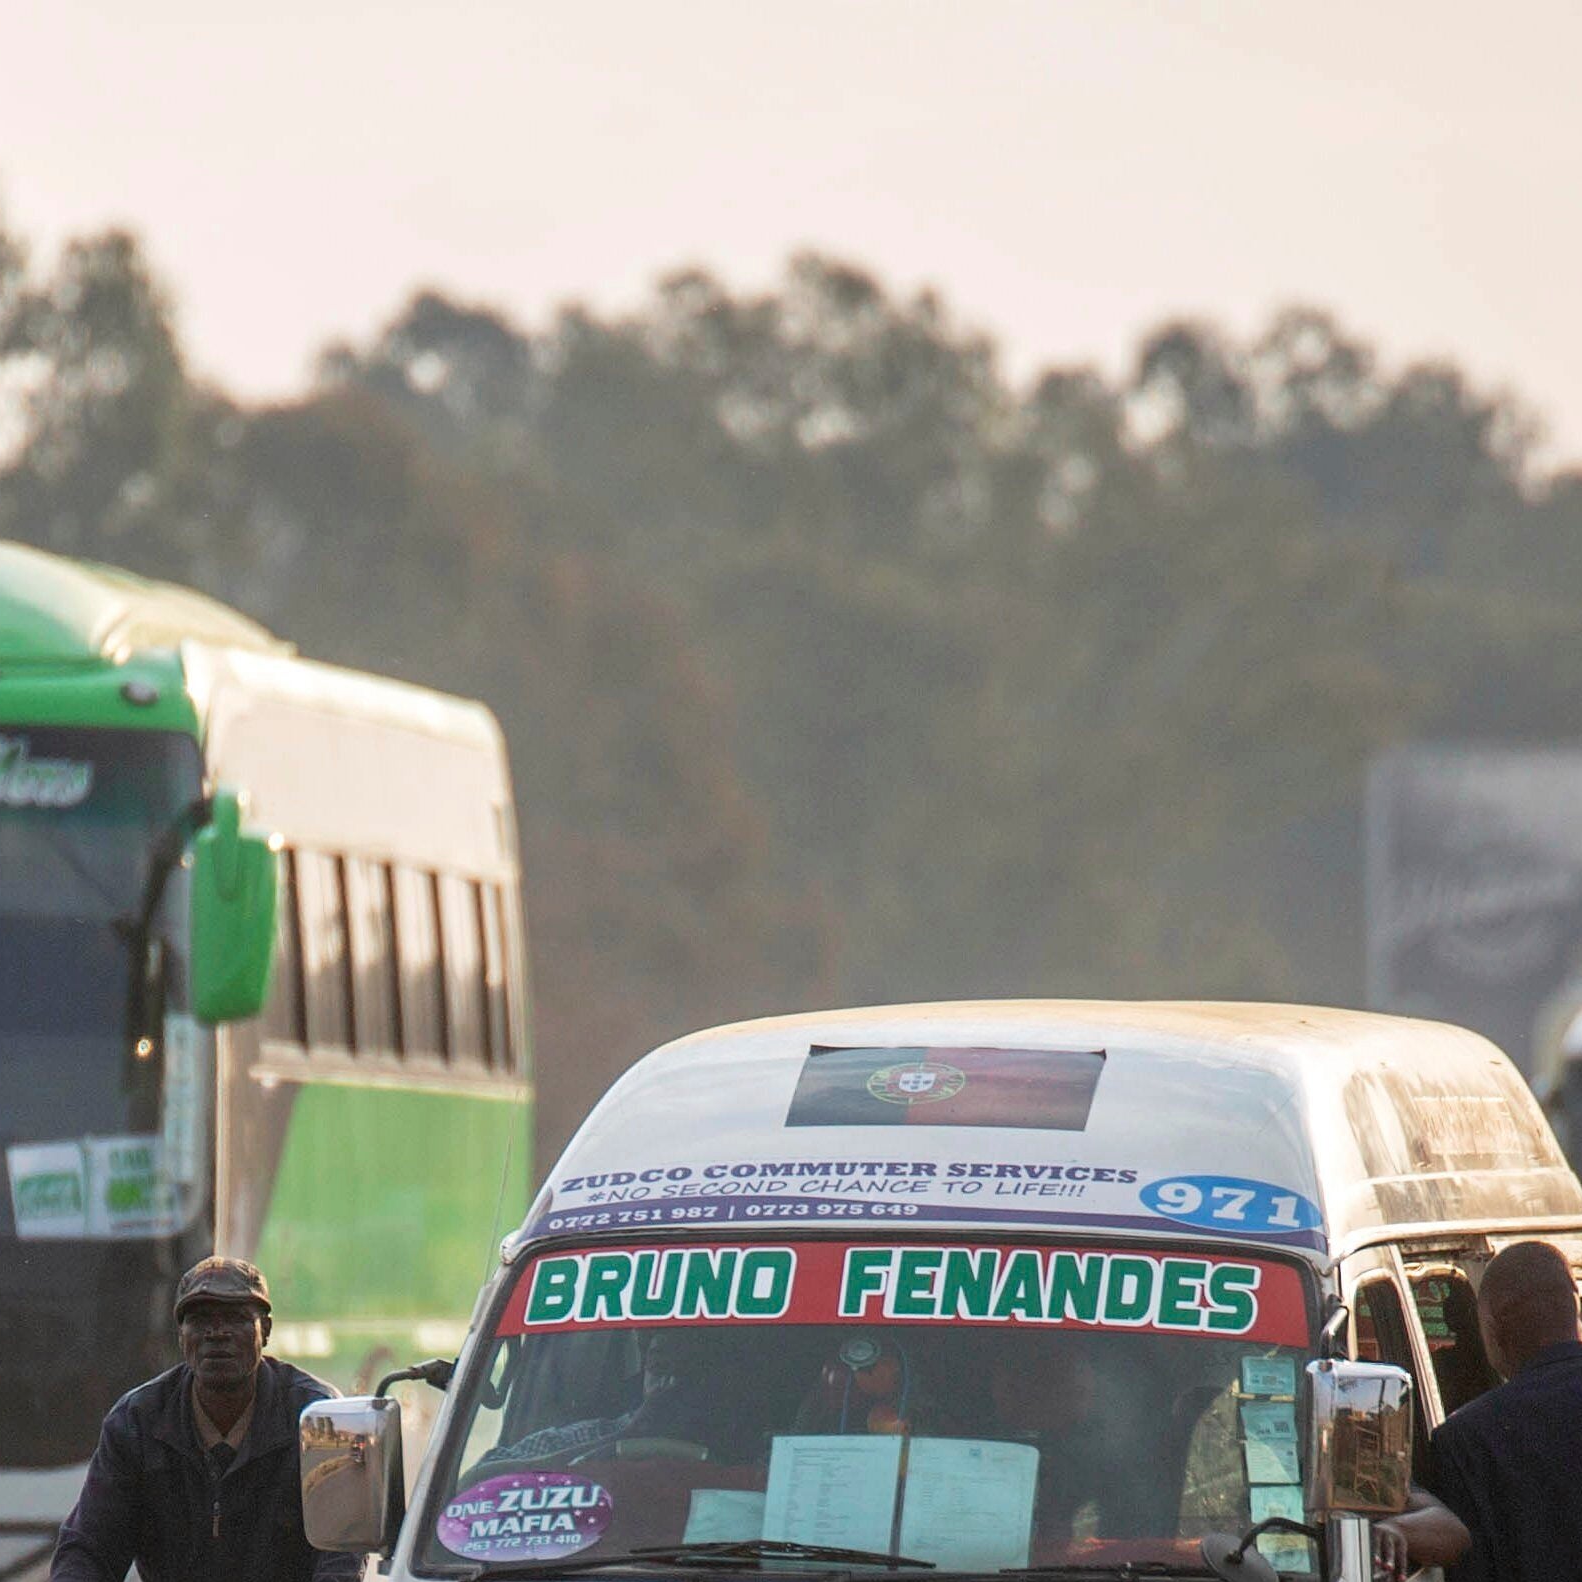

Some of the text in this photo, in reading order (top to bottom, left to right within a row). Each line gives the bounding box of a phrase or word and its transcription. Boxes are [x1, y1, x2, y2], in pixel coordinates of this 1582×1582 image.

[560, 1162, 1138, 1193] ZUDCO COMMUTER SERVICES
[587, 1178, 1088, 1203] #NO SECOND CHANCE TO LIFE!!!
[548, 1203, 920, 1231] 0772 751 987 0773 975 649
[1155, 1182, 1302, 1228] 971
[523, 1245, 1262, 1336] BRUNO FENANDES
[446, 1484, 602, 1519] ONE ZUZU
[469, 1512, 576, 1539] MAFIA
